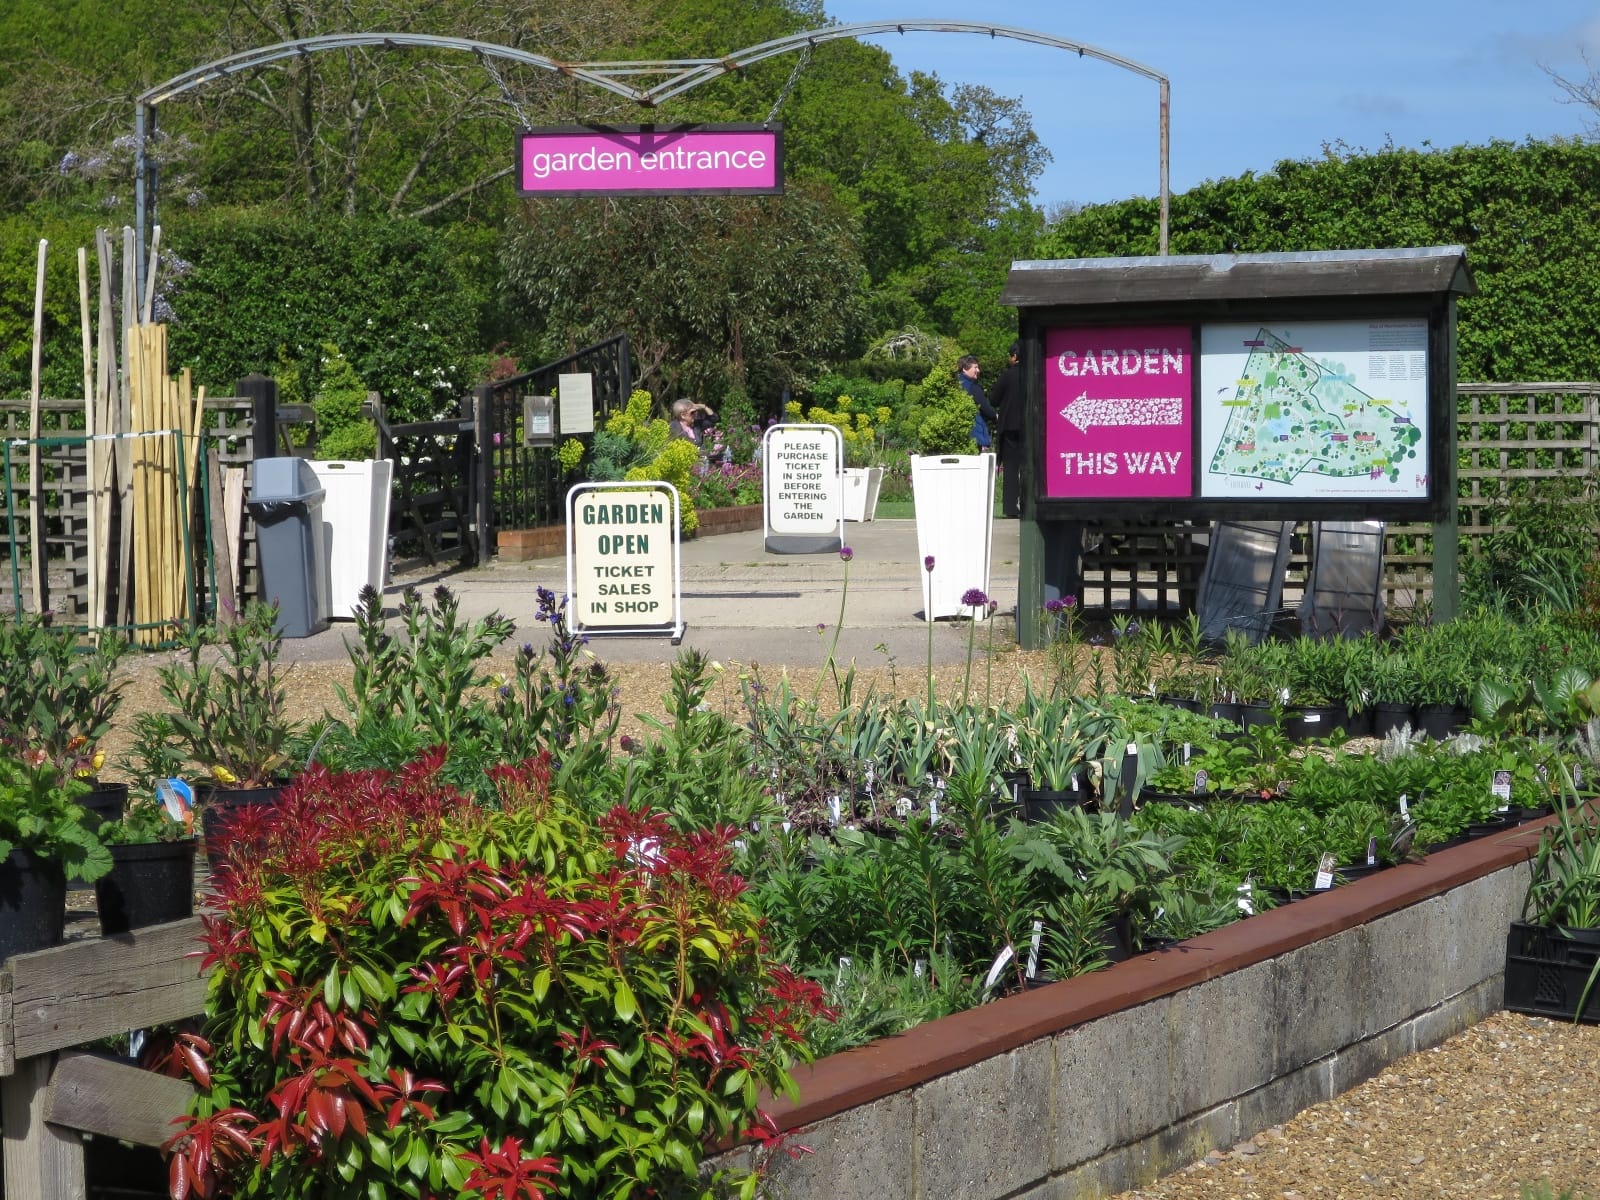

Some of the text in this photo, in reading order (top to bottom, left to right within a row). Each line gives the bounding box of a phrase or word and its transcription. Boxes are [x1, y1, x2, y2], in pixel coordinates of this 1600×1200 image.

[533, 146, 766, 178] garden entrance
[1058, 348, 1183, 376] GARDEN
[777, 452, 828, 460] PURCHASE
[1060, 452, 1182, 475] THIS WAY
[583, 504, 663, 525] GARDEN
[598, 535, 649, 555] OPEN
[594, 566, 654, 577] TICKET
[598, 584, 651, 595] SALES
[591, 601, 659, 613] IN SHOP
